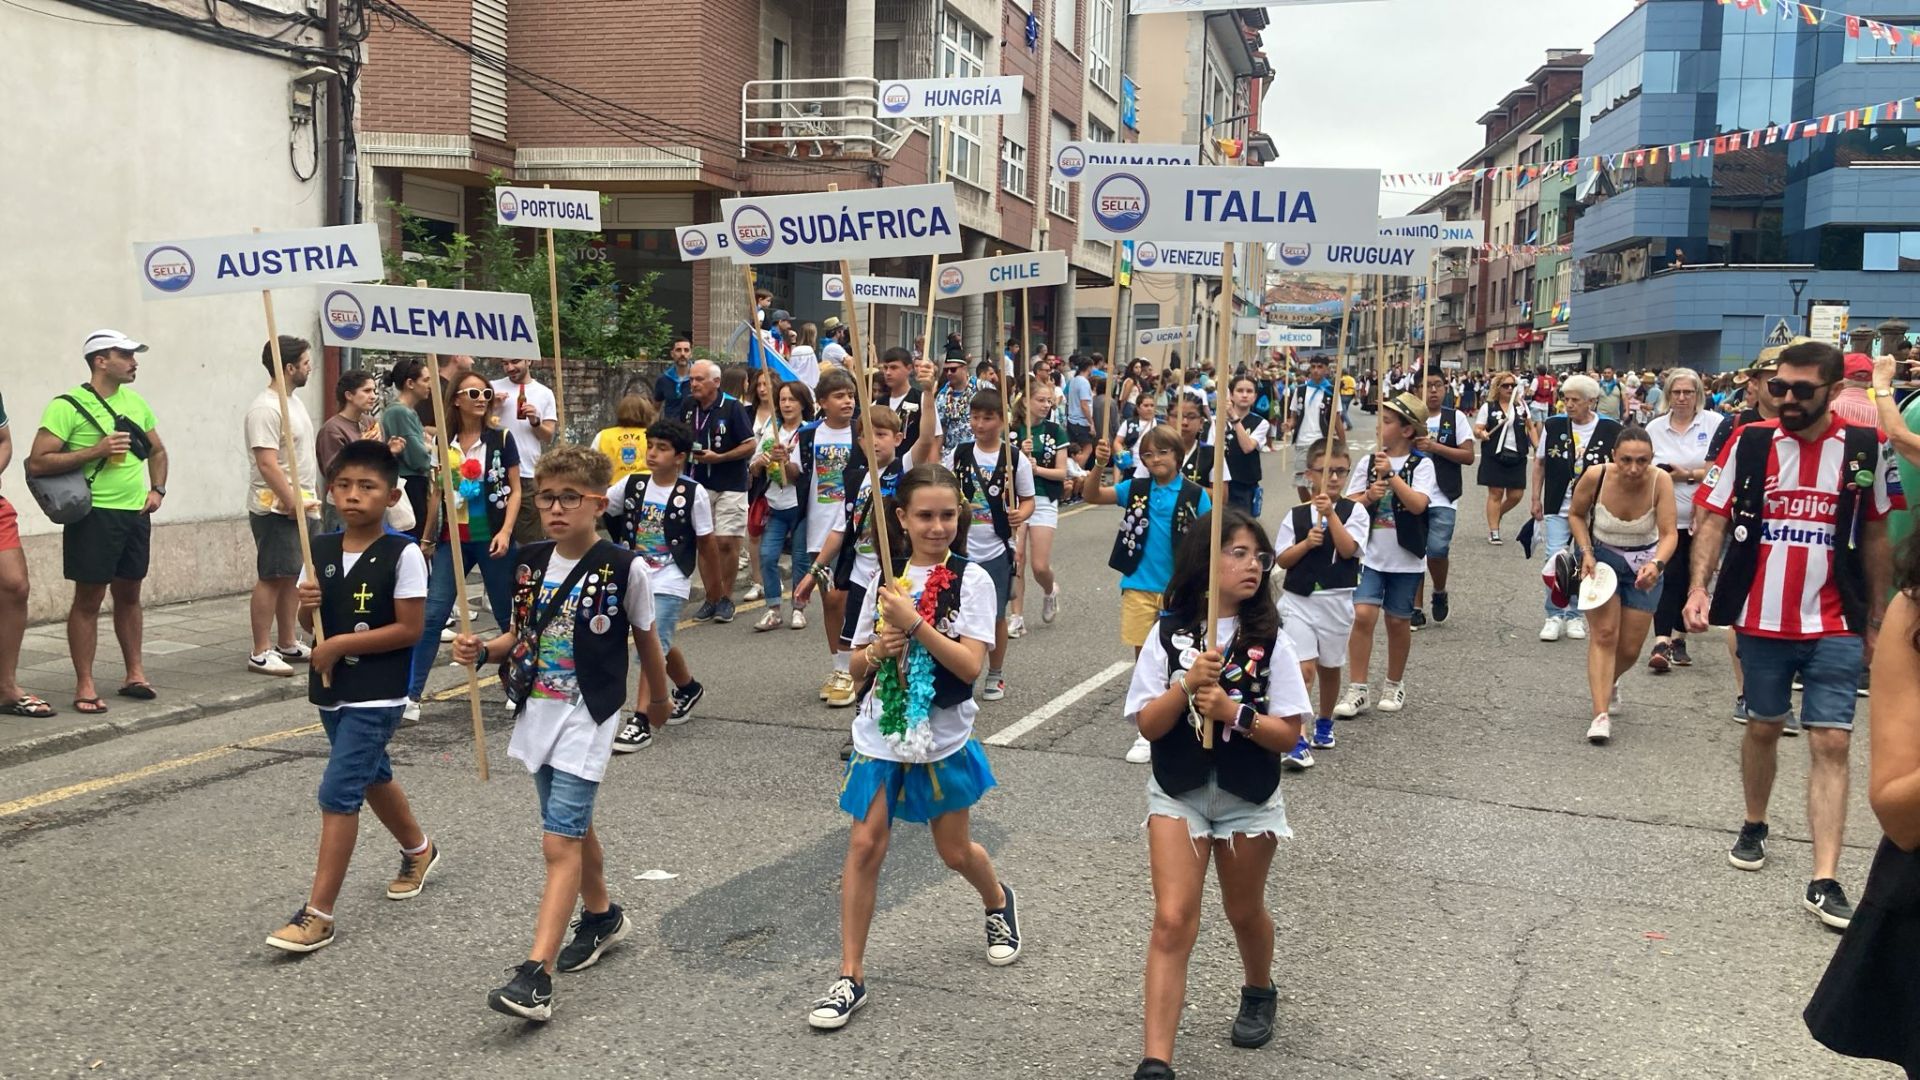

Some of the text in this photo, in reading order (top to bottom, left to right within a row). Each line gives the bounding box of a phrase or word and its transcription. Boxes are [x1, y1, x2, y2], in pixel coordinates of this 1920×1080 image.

[924, 85, 1002, 107] HUNGRÍA
[521, 199, 593, 221] PORTUGAL
[1101, 200, 1140, 211] SELLA
[1185, 190, 1317, 223] ITALIA
[738, 227, 769, 240] SELLA
[779, 205, 952, 246] SUDÁFRICA
[217, 243, 359, 280] AUSTRIA
[1327, 244, 1415, 266] URUGUAY
[153, 266, 188, 278] SELLA
[989, 262, 1040, 283] CHILE
[851, 283, 917, 299] RGENTINA
[331, 312, 360, 324] SELLA
[371, 305, 534, 343] ALEMANIA
[1156, 331, 1192, 342] UCRANA
[1279, 330, 1313, 342] MÉXICO
[617, 433, 640, 442] COYA
